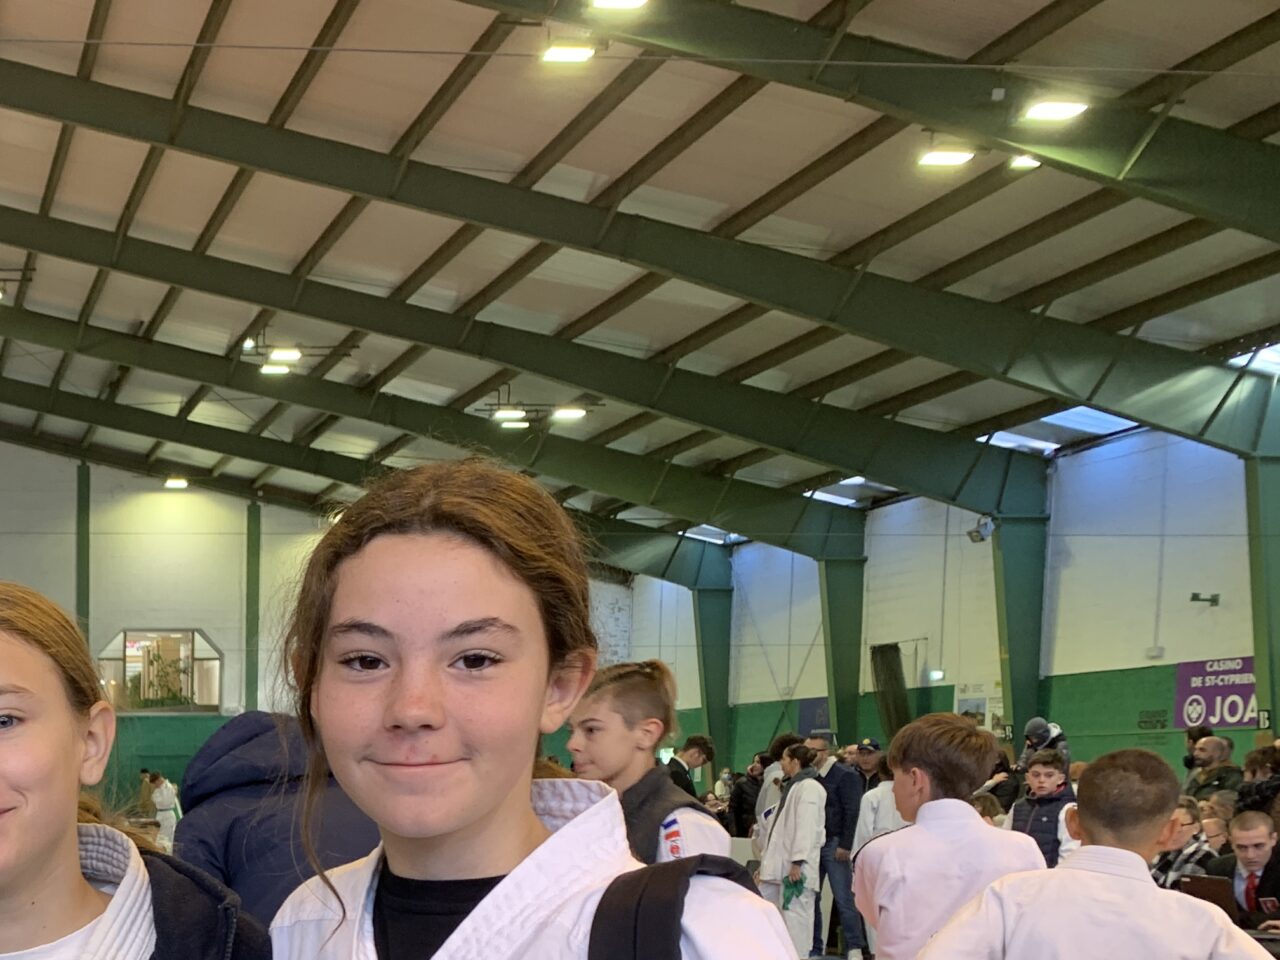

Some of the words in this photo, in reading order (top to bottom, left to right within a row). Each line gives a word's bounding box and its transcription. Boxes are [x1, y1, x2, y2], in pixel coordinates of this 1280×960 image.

[1205, 659, 1243, 672] CASINO
[1190, 676, 1203, 689] DE
[1209, 693, 1258, 724] JOA
